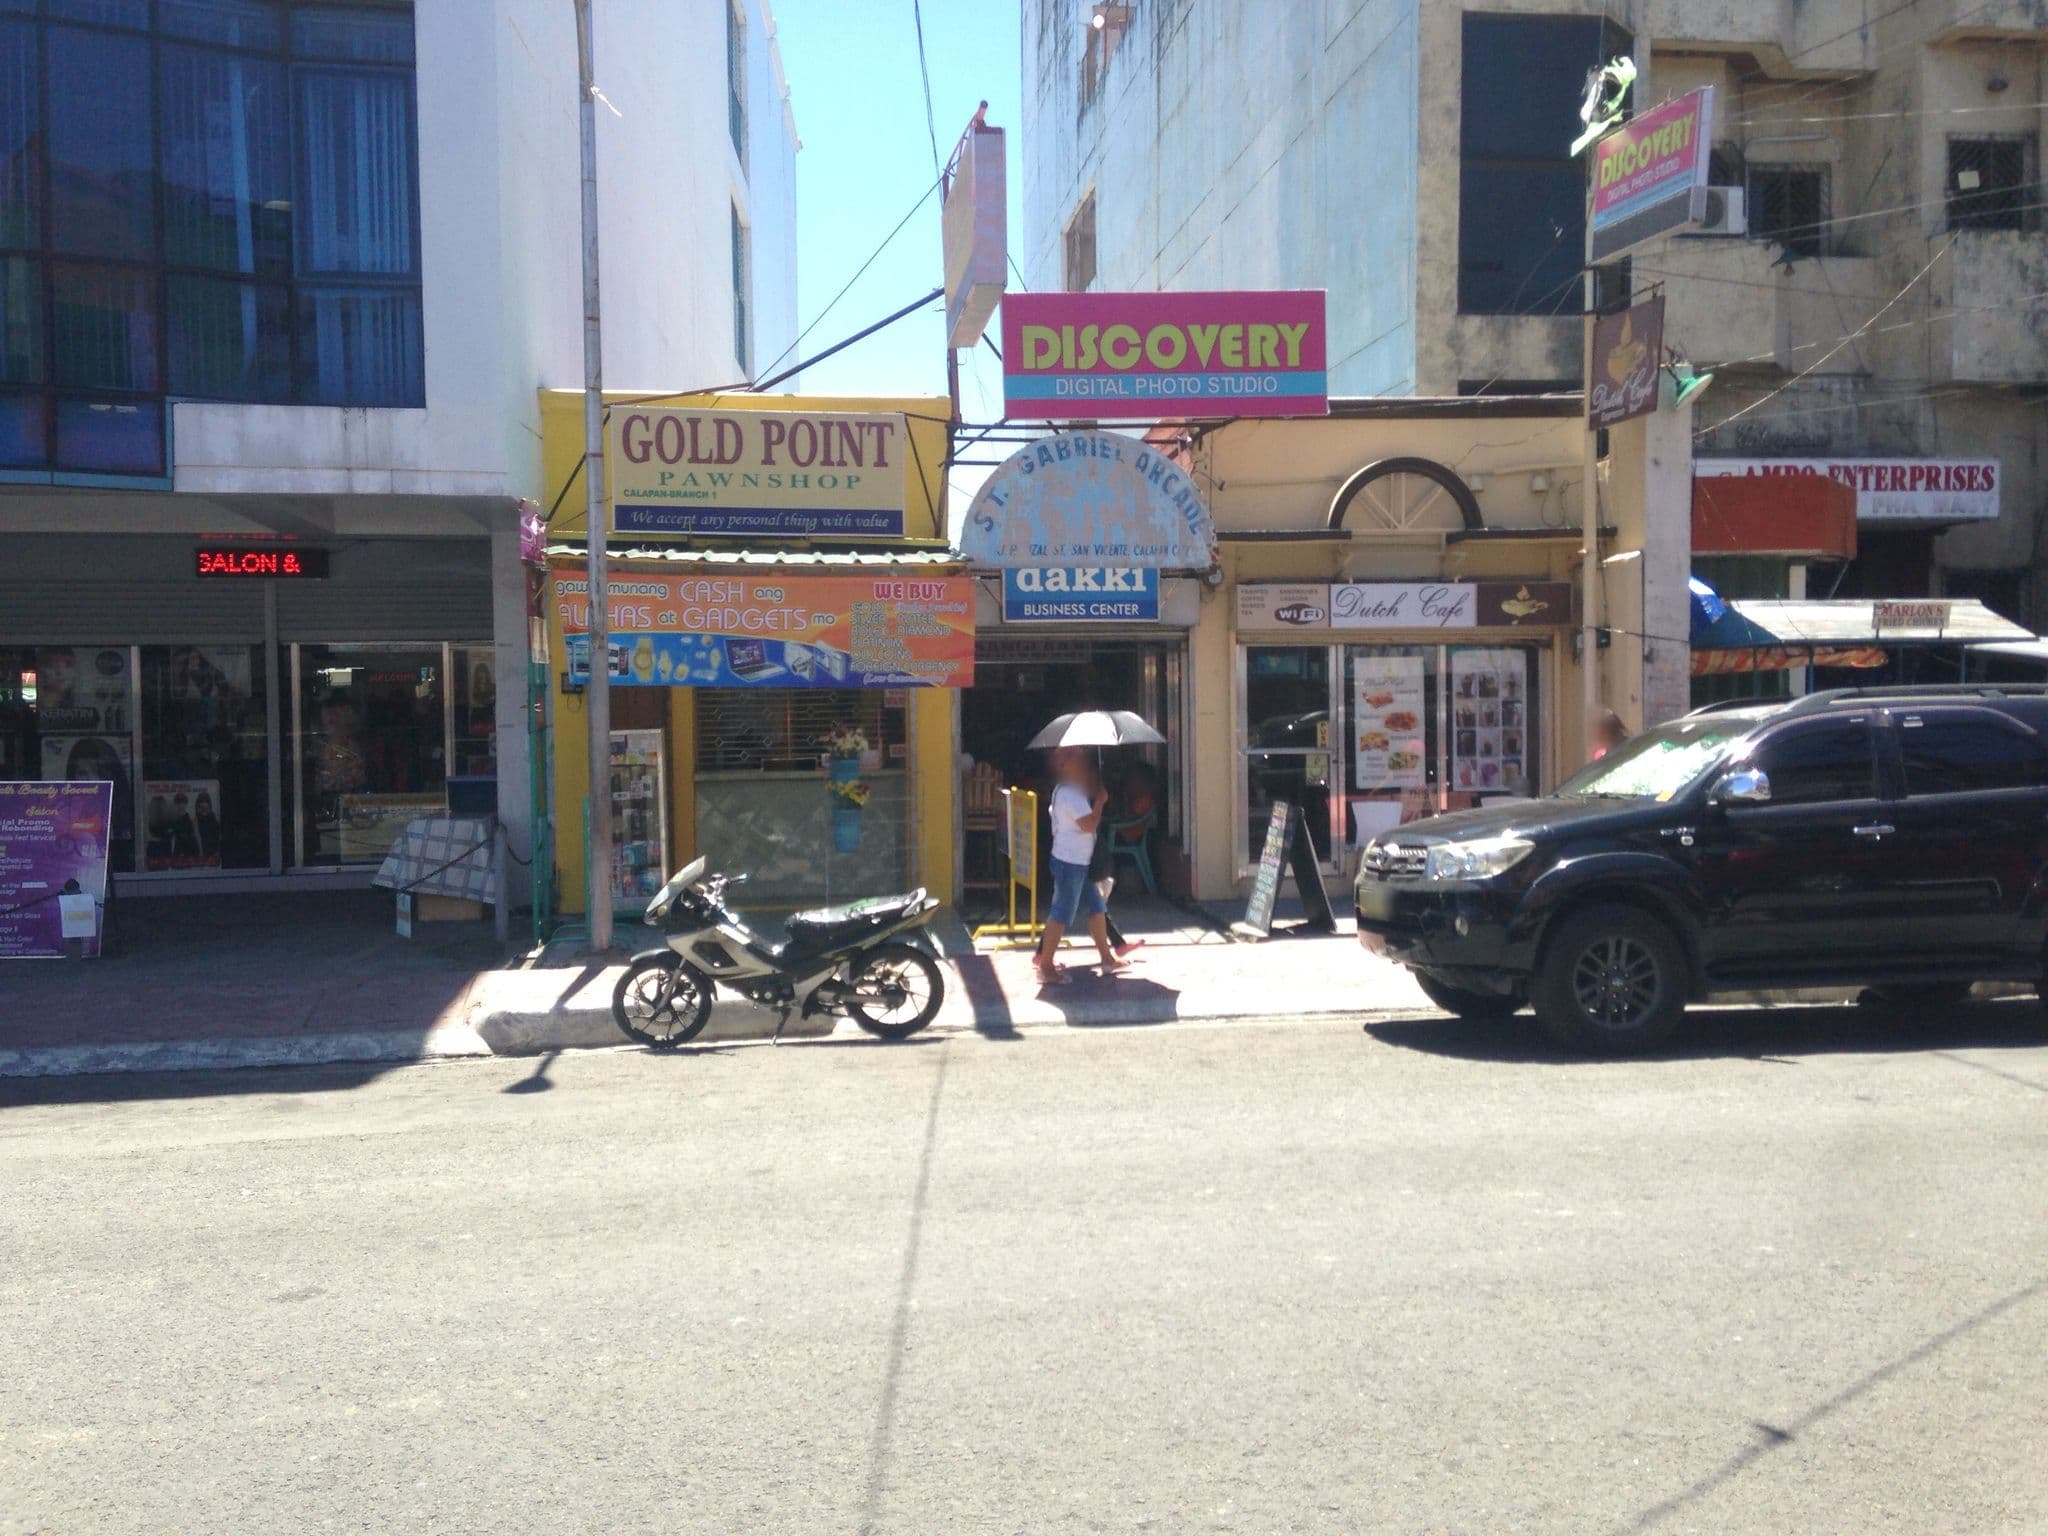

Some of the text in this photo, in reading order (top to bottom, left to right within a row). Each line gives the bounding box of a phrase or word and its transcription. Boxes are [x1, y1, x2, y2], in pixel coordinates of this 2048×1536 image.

[1599, 111, 1695, 190] DISCOVERY
[1021, 323, 1310, 370] DISCOVERY
[1055, 376, 1278, 395] DIGITAL PHOTO STUDIO
[621, 414, 895, 468] GOLD POINT
[658, 471, 862, 489] PAWNSHOP
[630, 510, 890, 531] We accept any personal thing with value
[199, 553, 300, 573] SALON &
[607, 582, 668, 600] munang
[679, 580, 745, 603] CASH
[754, 584, 784, 602] ang
[873, 582, 946, 600] WE BUY
[1024, 604, 1140, 616] BUSINESS CENTER
[1332, 585, 1470, 627] Dutch Cafe
[559, 604, 836, 631] ALHAS at GADGETS mo
